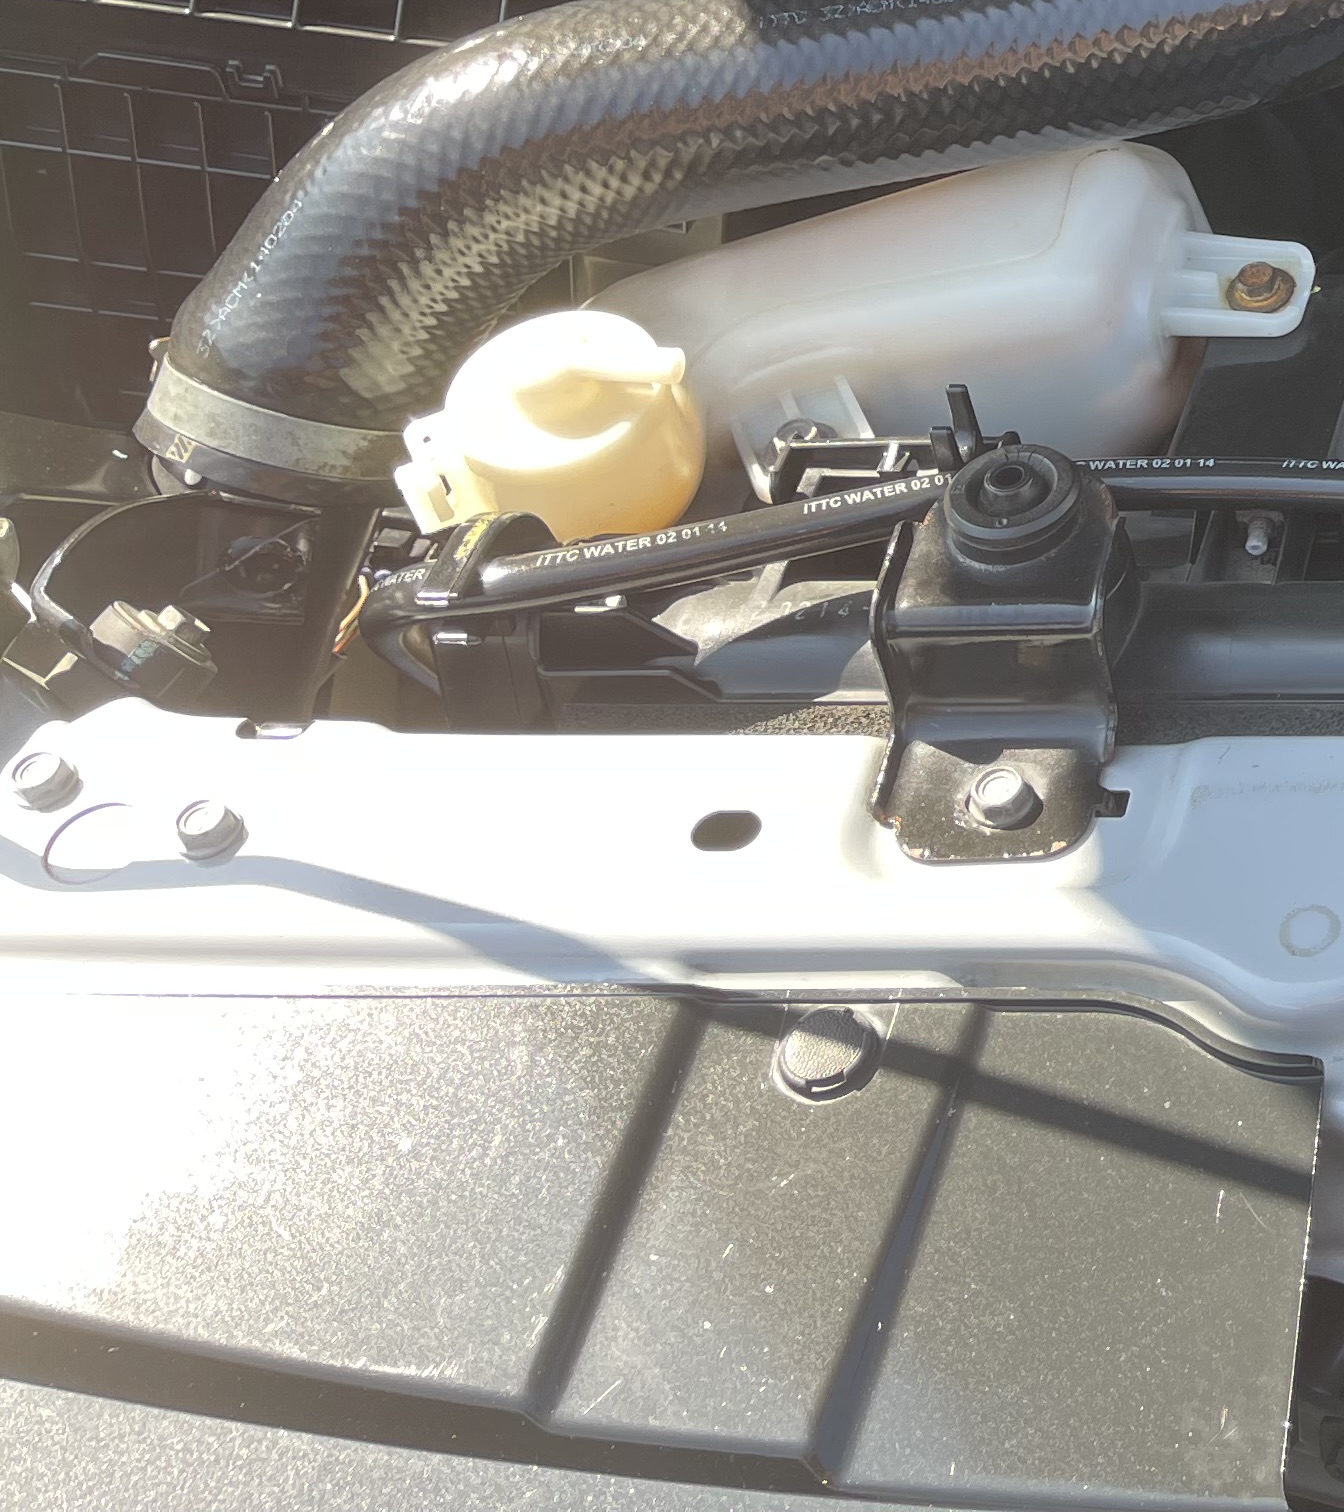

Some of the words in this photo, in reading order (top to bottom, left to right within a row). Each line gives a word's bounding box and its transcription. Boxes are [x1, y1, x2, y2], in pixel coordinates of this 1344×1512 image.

[1089, 459, 1149, 471] WATER
[1152, 458, 1171, 469] 02
[1174, 458, 1191, 469] 01
[1197, 458, 1215, 468] 14
[803, 497, 842, 515] ITTC
[845, 482, 908, 506] WATER
[911, 476, 931, 491] 02
[536, 550, 579, 567] ITTC
[584, 537, 652, 558] WATER
[656, 532, 677, 546] 02
